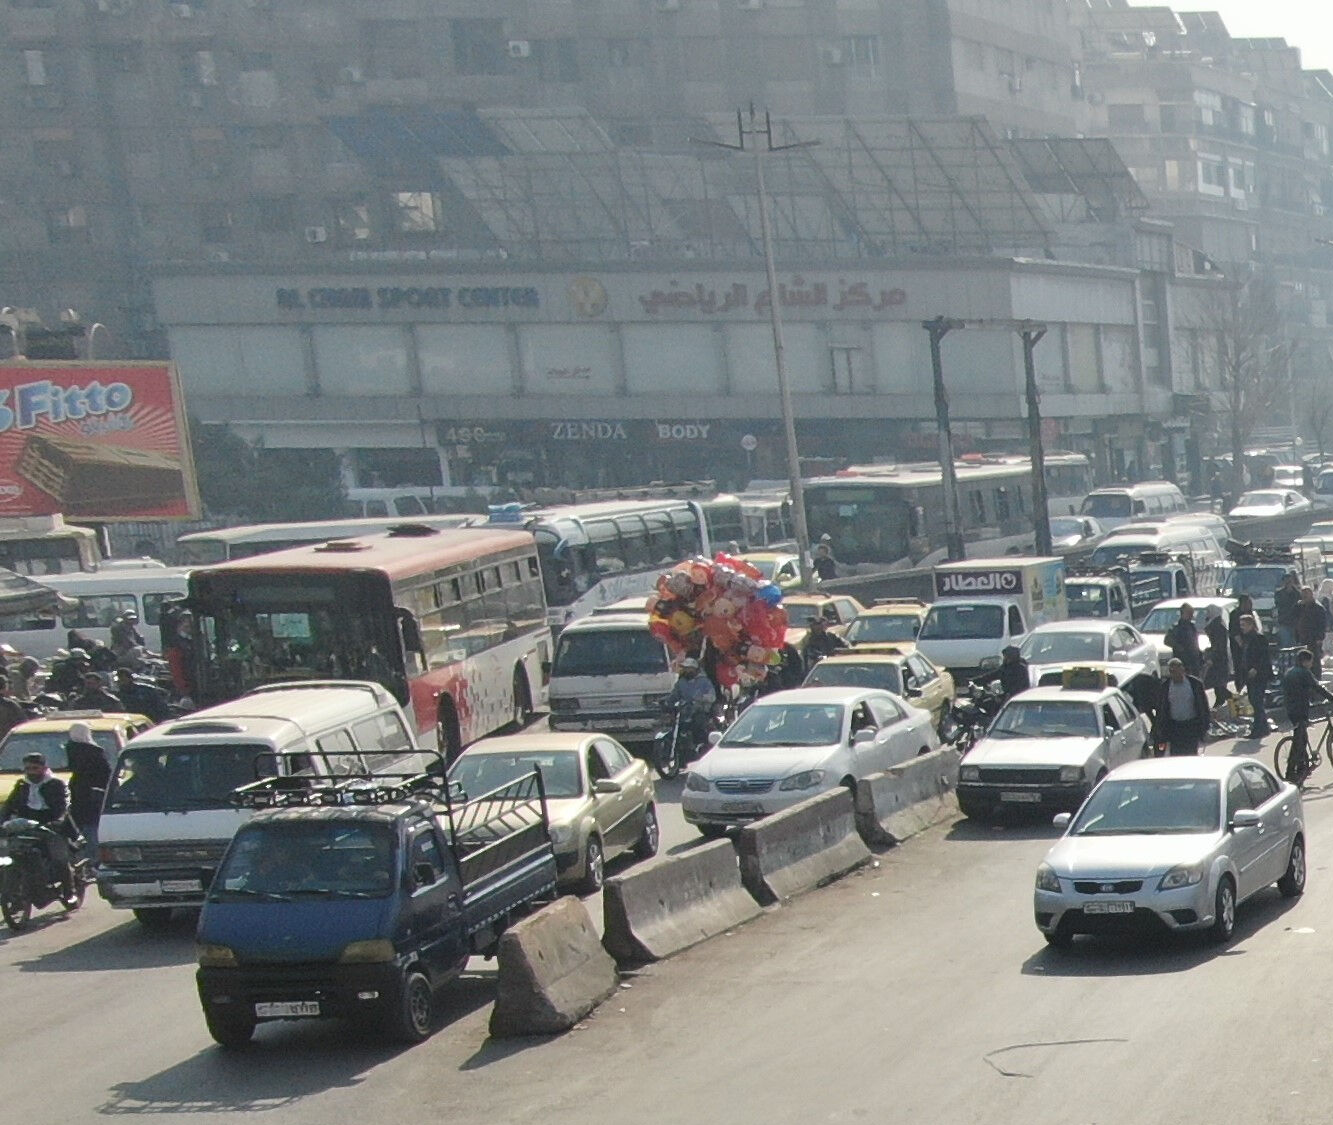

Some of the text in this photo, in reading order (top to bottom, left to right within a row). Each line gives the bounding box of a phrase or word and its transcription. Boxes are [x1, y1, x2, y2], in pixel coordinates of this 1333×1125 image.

[638, 274, 907, 316] مركز الشام الرياضي
[14, 380, 133, 429] Fitto
[551, 422, 627, 440] ZENDA
[656, 423, 711, 440] BODY
[942, 573, 1001, 592] العطار
